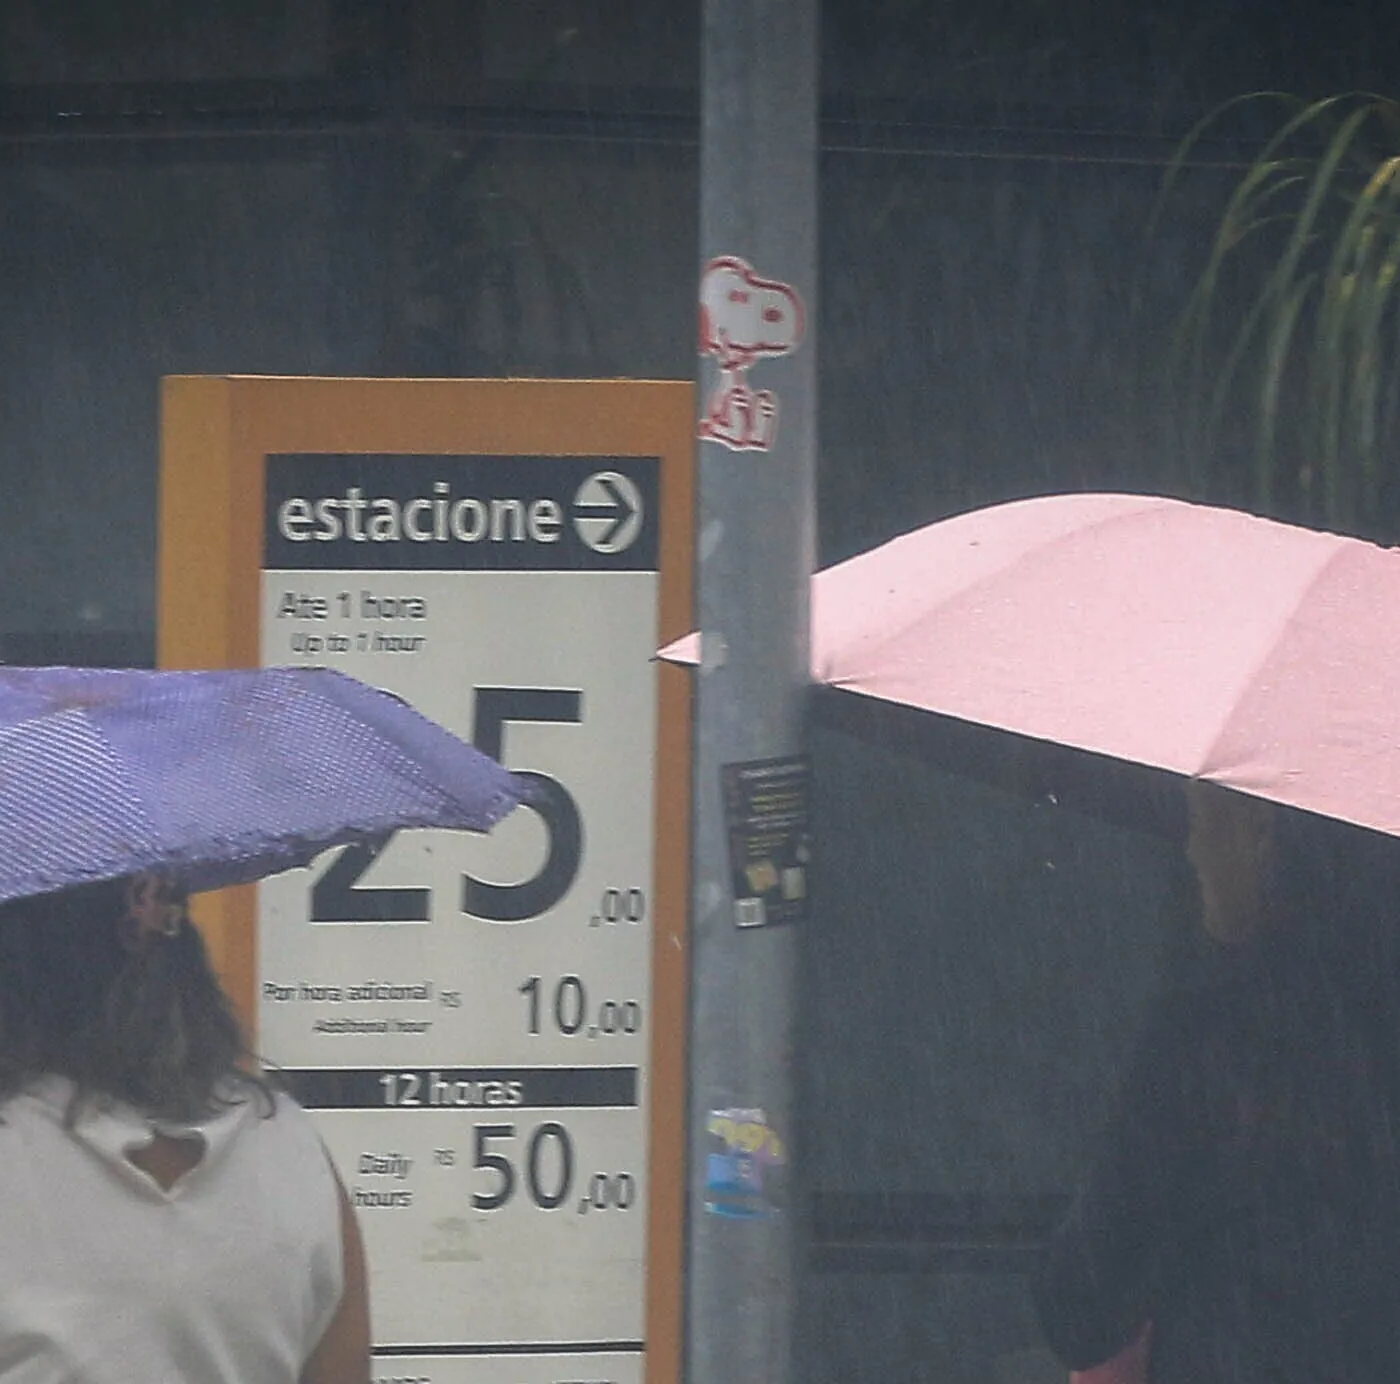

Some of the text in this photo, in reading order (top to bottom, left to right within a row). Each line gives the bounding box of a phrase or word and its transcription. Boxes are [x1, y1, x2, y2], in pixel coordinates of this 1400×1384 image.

[276, 481, 562, 542] estacione
[336, 592, 351, 619] 1
[360, 590, 428, 620] hora
[371, 631, 427, 652] hour
[299, 979, 343, 1002] hora
[347, 979, 432, 1001] adicional
[518, 975, 642, 1038] 10,00
[379, 1072, 523, 1107] 12 horas
[358, 1152, 414, 1179] Daily
[471, 1123, 636, 1213] 50,00
